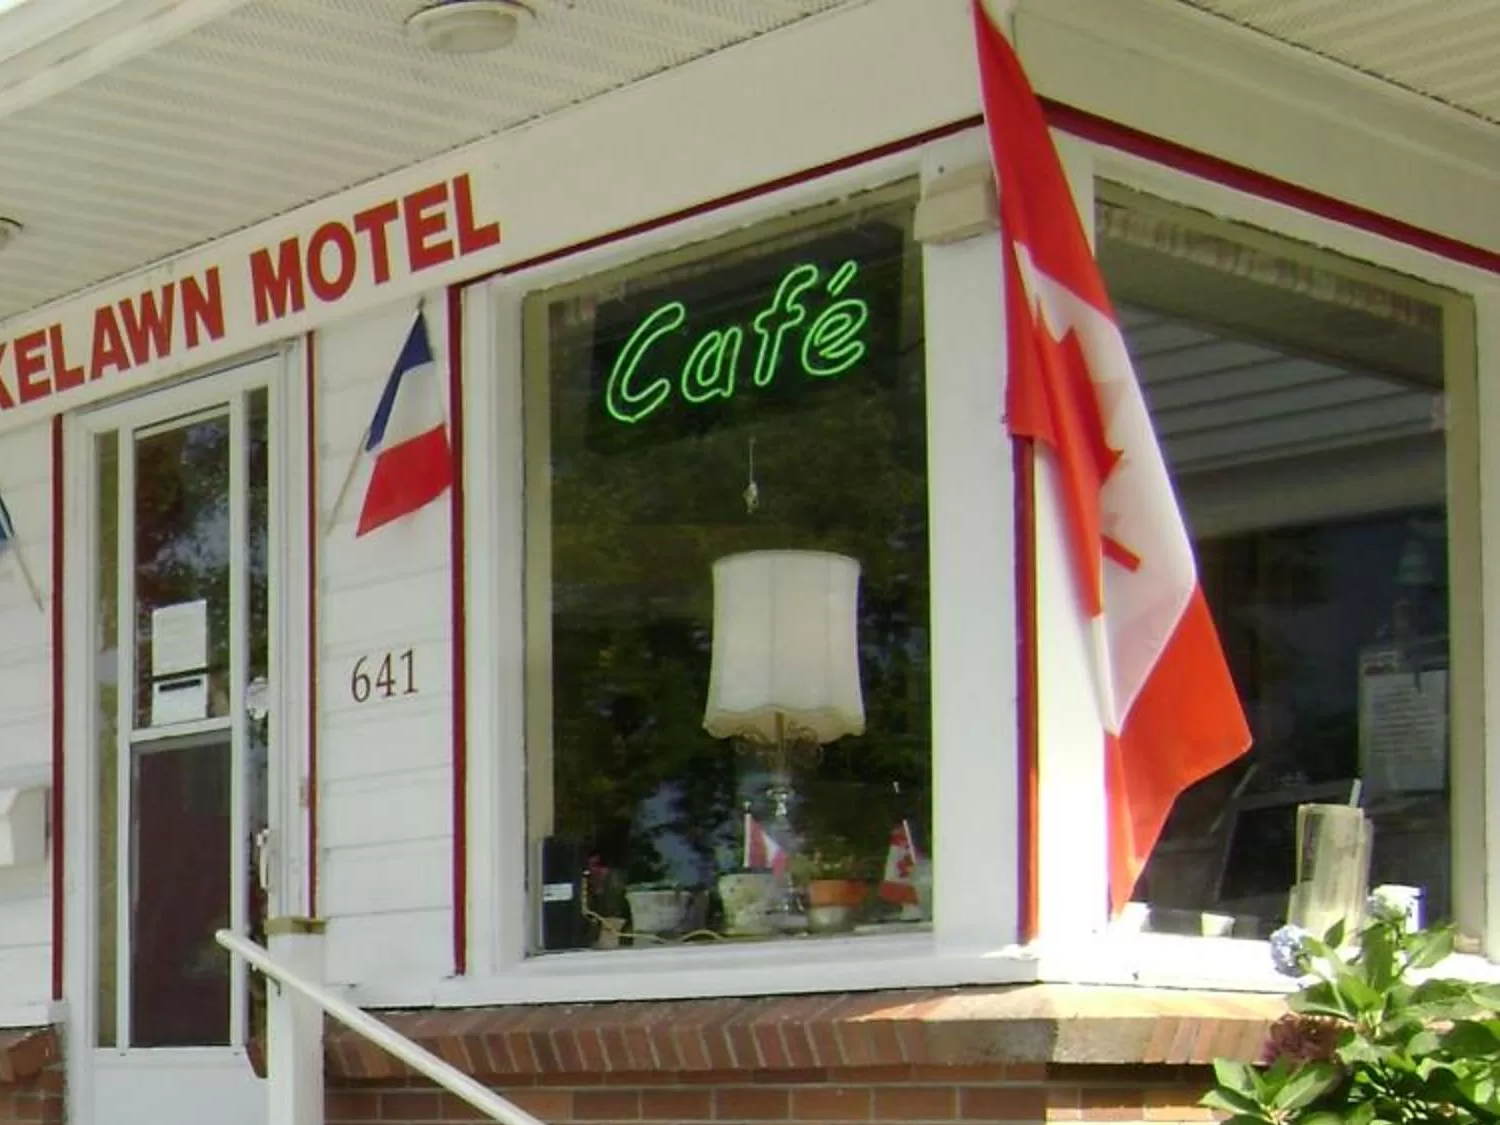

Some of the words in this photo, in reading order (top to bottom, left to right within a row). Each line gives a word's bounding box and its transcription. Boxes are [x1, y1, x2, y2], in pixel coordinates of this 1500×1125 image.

[249, 173, 501, 325] MOTEL
[605, 260, 868, 422] Café
[351, 649, 419, 703] 641
